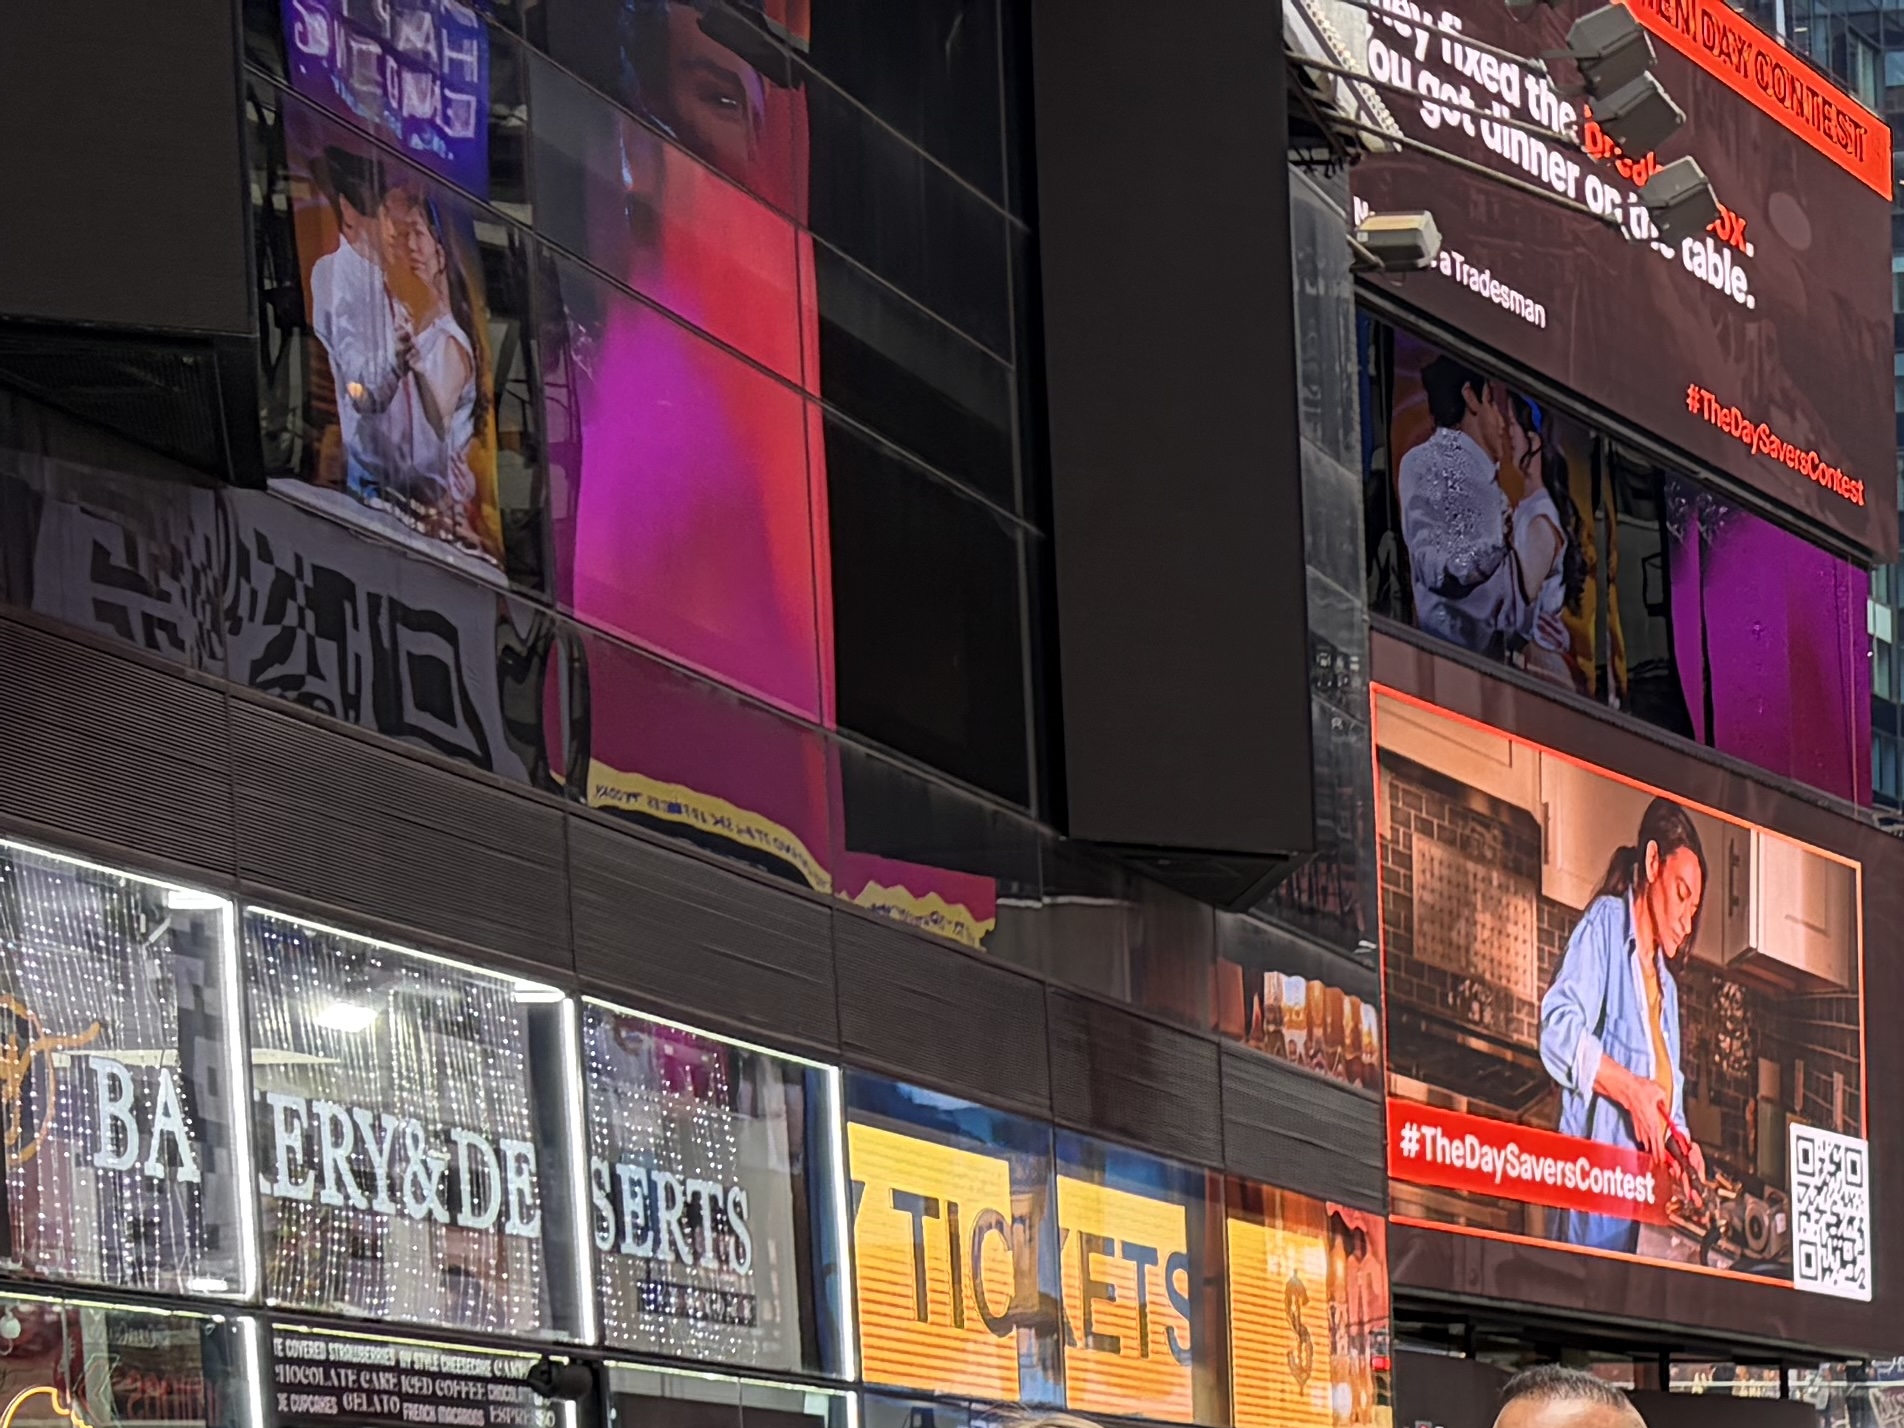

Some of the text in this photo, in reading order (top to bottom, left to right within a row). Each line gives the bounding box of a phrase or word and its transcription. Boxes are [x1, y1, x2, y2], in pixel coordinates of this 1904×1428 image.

[1418, 69, 1476, 137] got
[1480, 100, 1581, 199] dinner
[1438, 11, 1579, 136] fixed the
[1702, 12, 1868, 163] DAY CONTEST
[1686, 383, 1866, 506] #TheDaySaversContest
[1400, 1121, 1657, 1204] #TheDaySaversContest
[343, 1392, 400, 1414] GELATO
[401, 1374, 433, 1396] ICED
[435, 1378, 487, 1400] COFFEE
